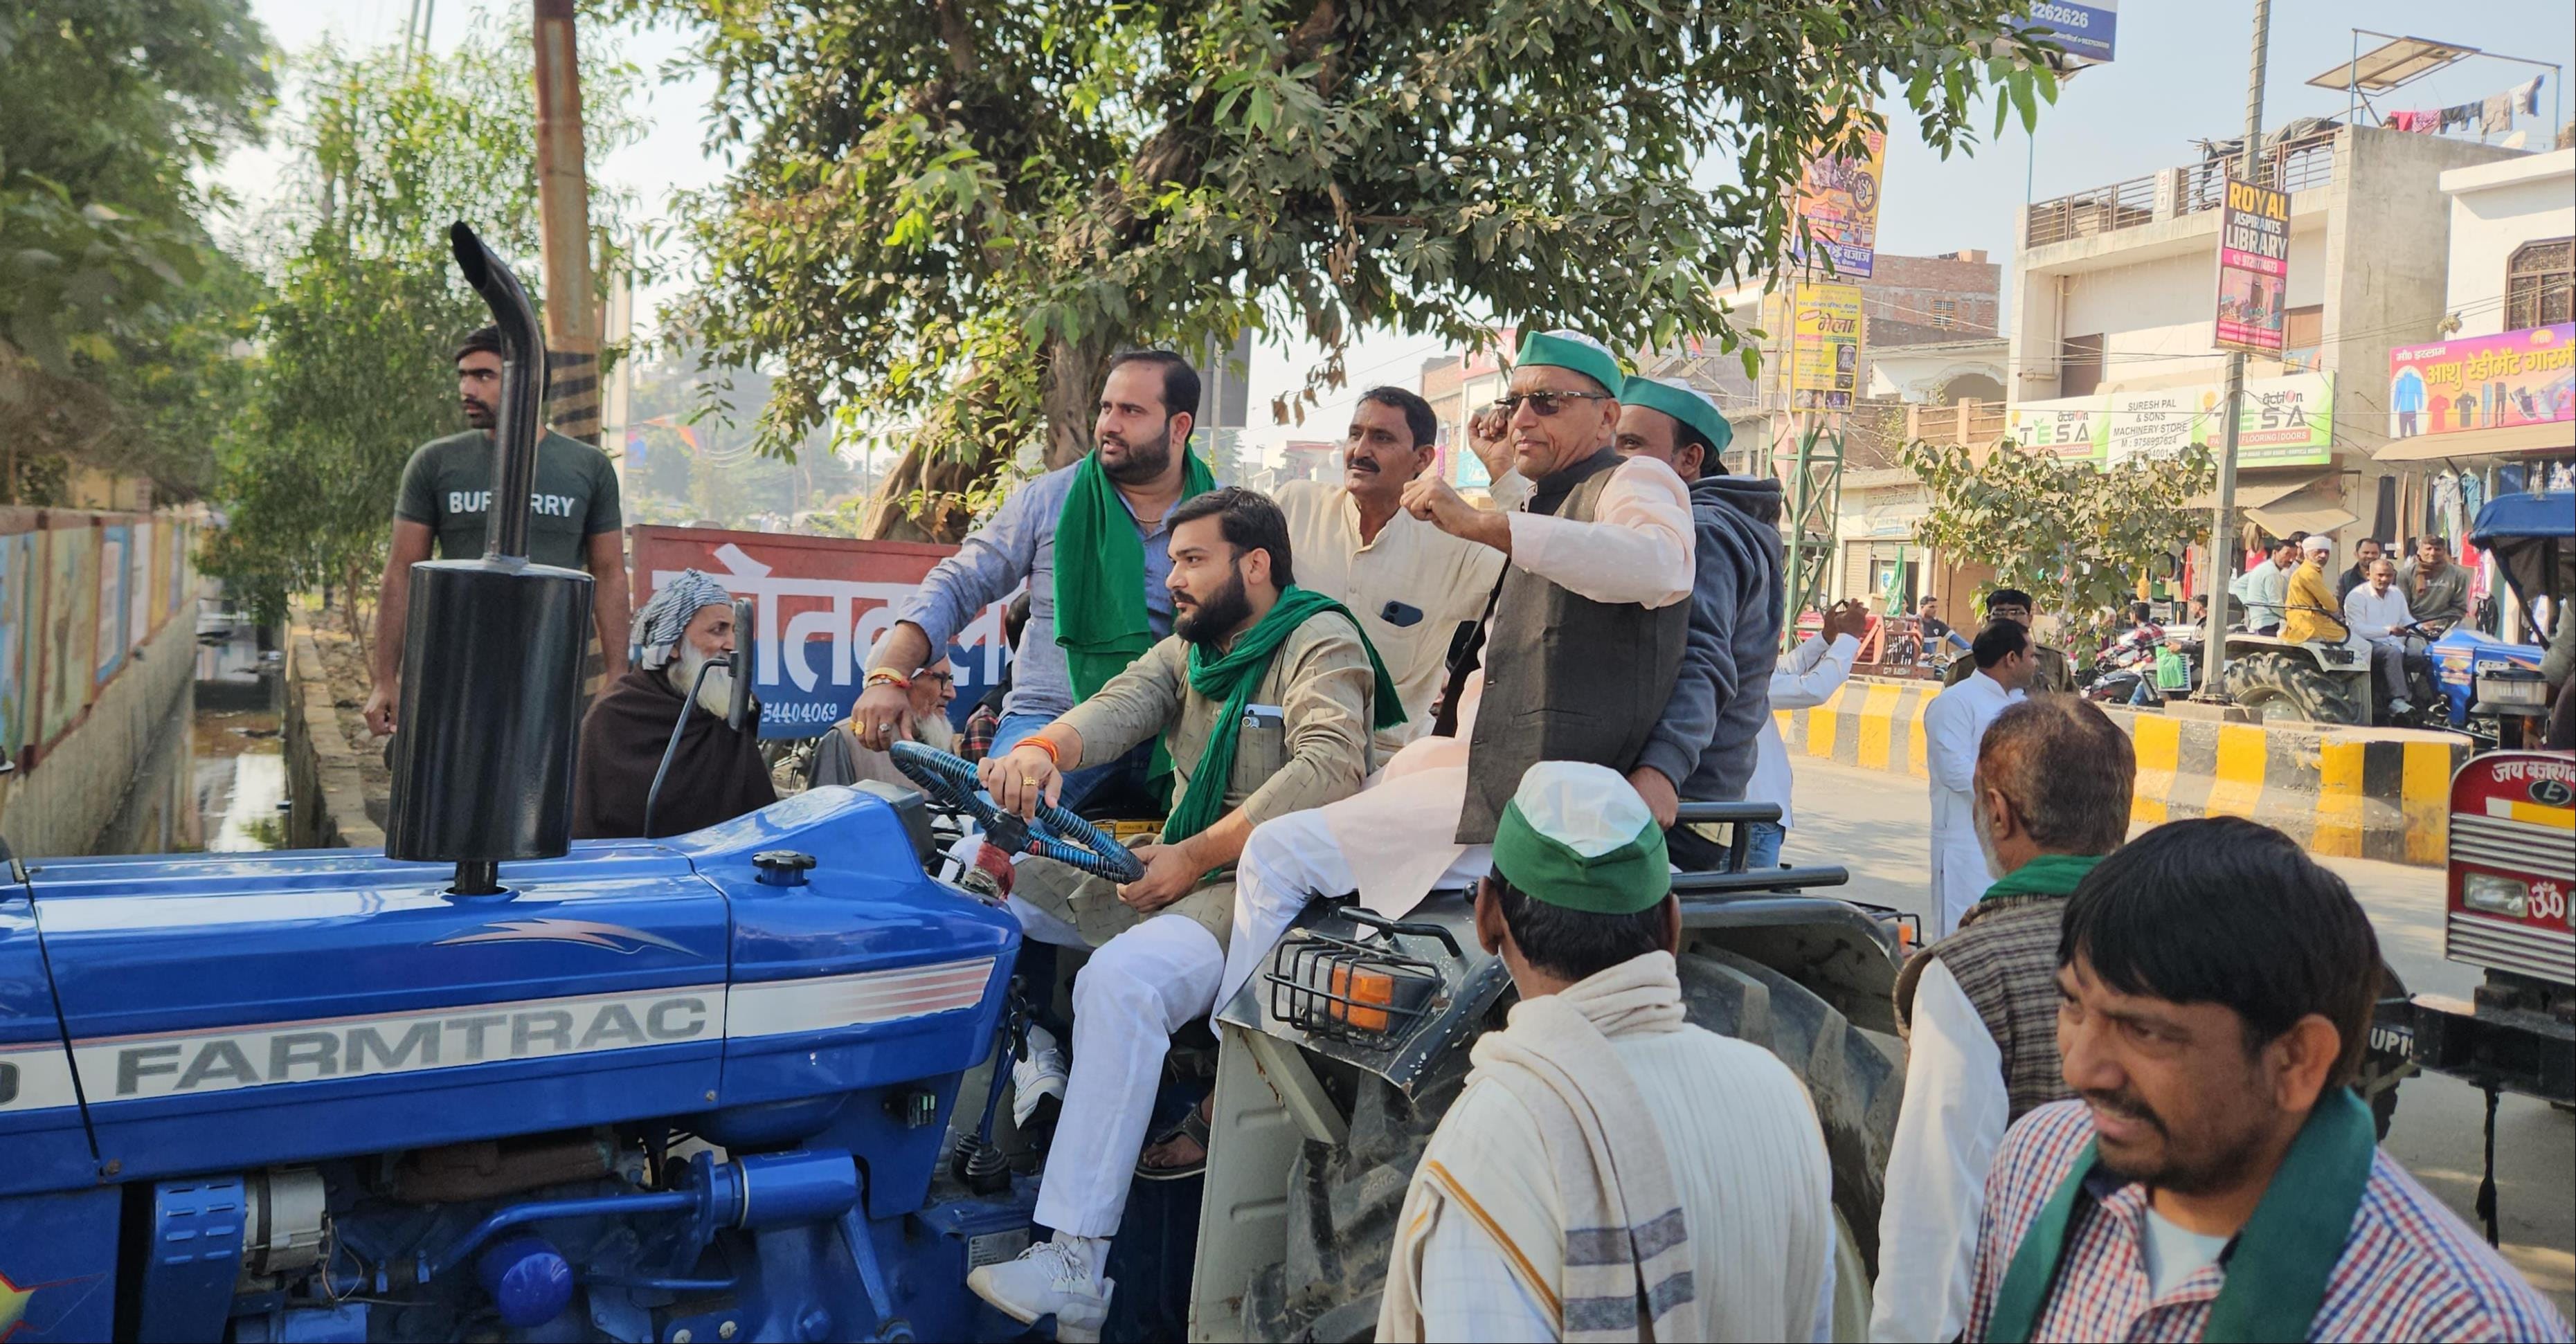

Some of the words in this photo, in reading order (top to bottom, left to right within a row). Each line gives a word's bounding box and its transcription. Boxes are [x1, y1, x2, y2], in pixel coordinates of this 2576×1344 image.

[2229, 181, 2289, 221] ROYAL
[2234, 211, 2281, 234] ASPIRANTS
[2225, 225, 2287, 260] LIBRARY
[1818, 313, 1855, 333] मेला
[2426, 361, 2464, 391] आशु
[2524, 338, 2575, 372] गारमें
[2128, 401, 2159, 411] SURESH
[2161, 399, 2177, 408] PAL
[2143, 412, 2165, 421] SONS
[2019, 422, 2090, 445] TESA
[2114, 425, 2159, 436] MACHINERY
[2161, 423, 2188, 433] STORE
[2242, 434, 2277, 443] FLOORING
[2280, 431, 2307, 440] DOORS
[449, 491, 575, 517] BURRY
[761, 702, 838, 723] 54404069
[2492, 761, 2527, 783] जय
[116, 997, 706, 1096] FARMTRAC
